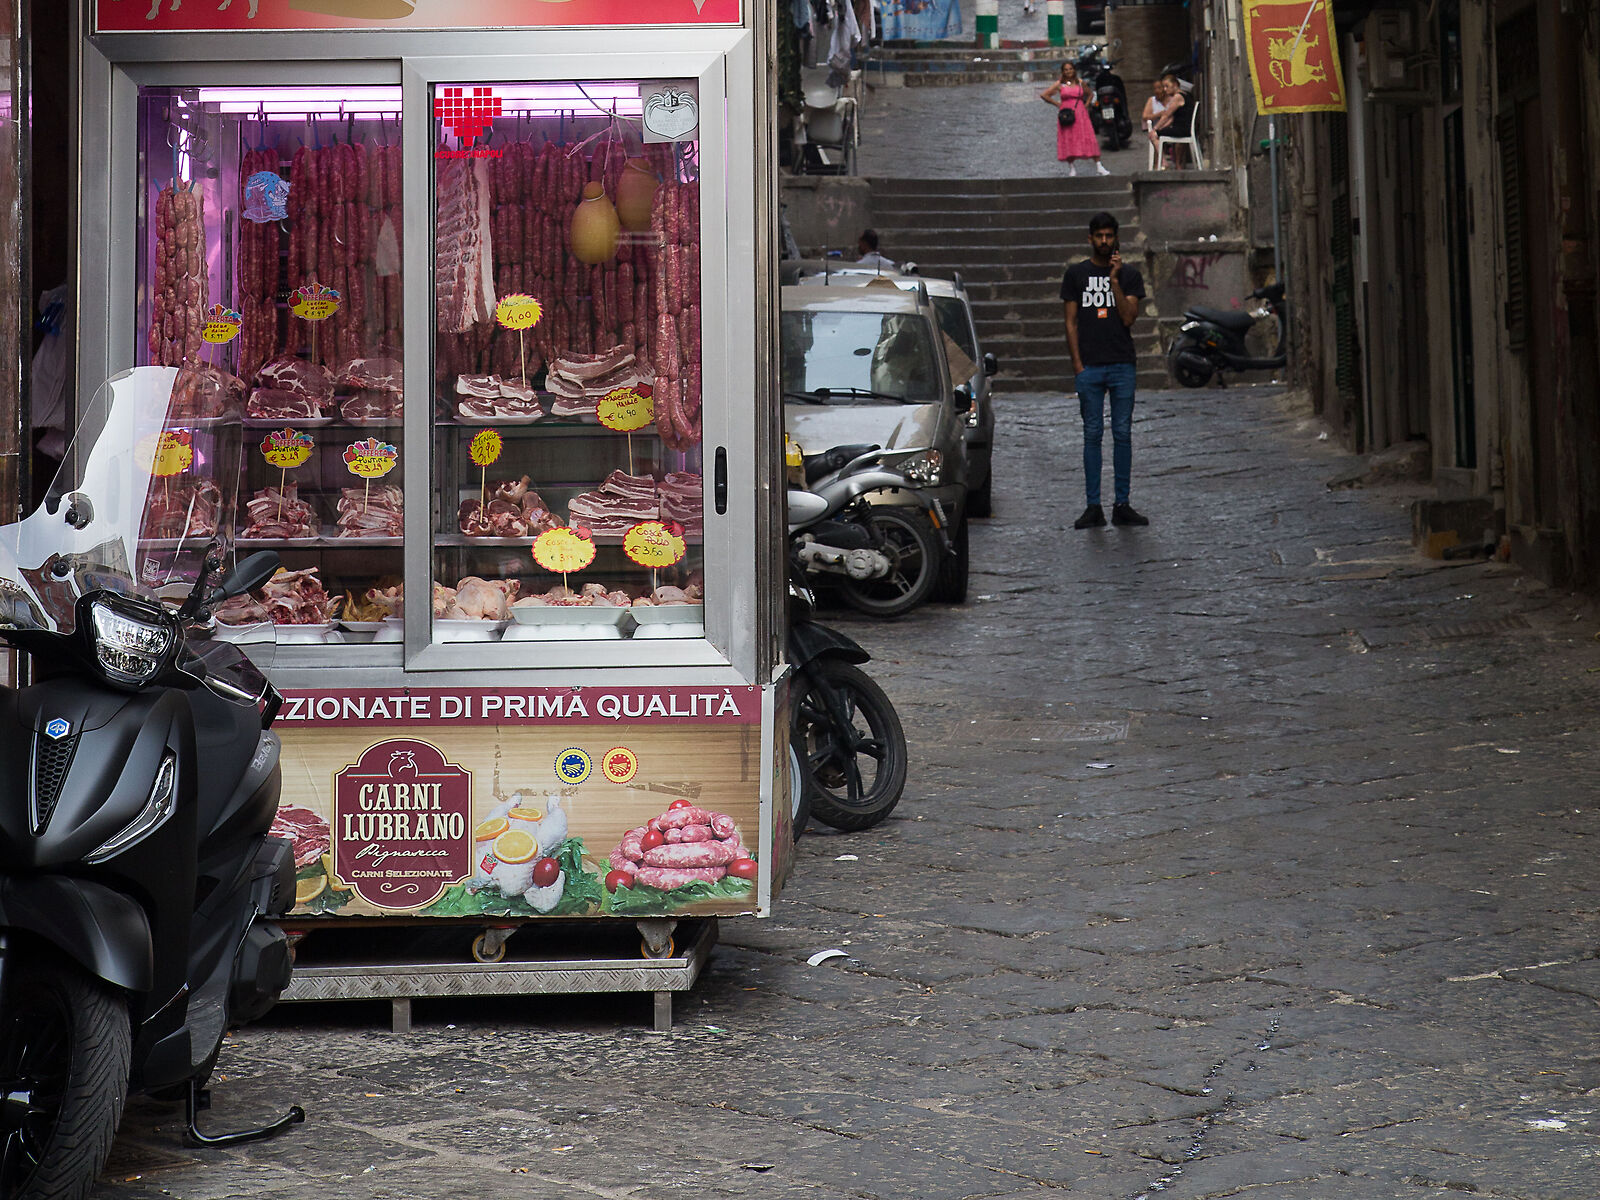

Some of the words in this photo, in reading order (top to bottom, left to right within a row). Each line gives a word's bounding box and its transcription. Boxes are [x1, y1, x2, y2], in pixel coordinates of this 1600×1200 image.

[1085, 276, 1111, 292] JUS
[1082, 291, 1105, 308] DO
[440, 696, 472, 718] DI
[481, 695, 589, 718] PRIMA
[596, 688, 742, 721] QUALITÀ
[359, 783, 442, 811] CARNI
[343, 812, 465, 842] LUBRANO
